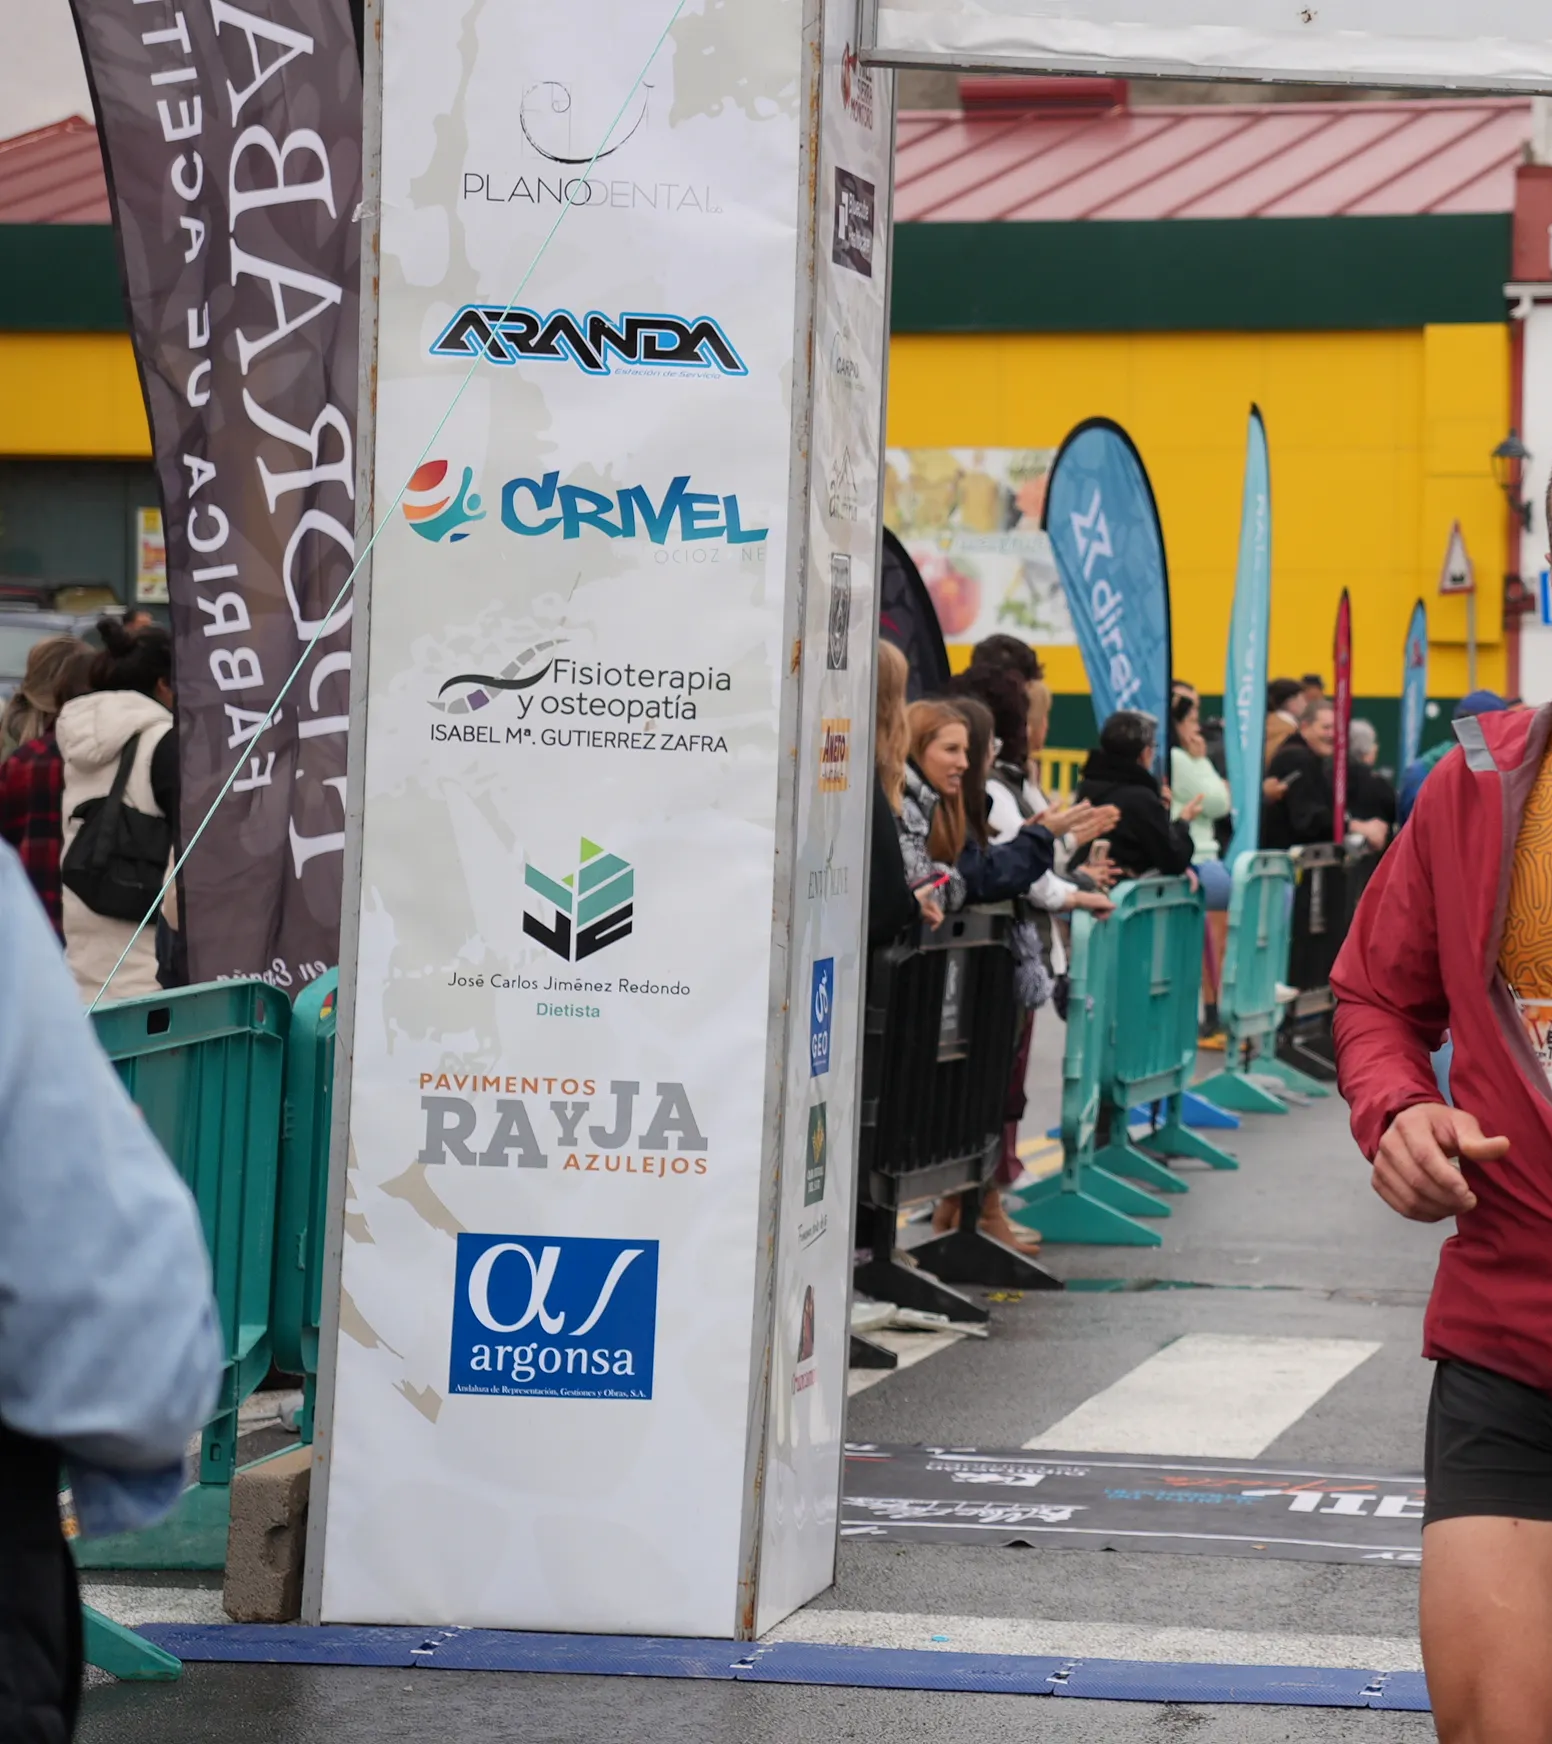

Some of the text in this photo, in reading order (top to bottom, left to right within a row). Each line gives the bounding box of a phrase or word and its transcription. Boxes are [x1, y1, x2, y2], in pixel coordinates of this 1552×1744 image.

[429, 304, 749, 376] ARANDA
[614, 367, 722, 380] Estación de Servicio
[501, 470, 769, 545] CRIVEL
[552, 658, 732, 695] Fisioterapia
[517, 692, 698, 724] y osteopatía
[430, 724, 502, 744] ISABEL
[540, 727, 657, 751] GUTIERREZ
[660, 733, 729, 753] ZAFRA
[447, 972, 691, 996] José Carlos Jiménez Redondo
[535, 1002, 601, 1018] Dietista
[812, 1032, 829, 1059] GEO
[419, 1073, 597, 1097] PAVIMENTOS
[562, 1153, 709, 1178] AZULEJOS
[469, 1342, 636, 1383] argonsa
[490, 1385, 500, 1394] de
[501, 1385, 559, 1396] Representación,
[560, 1387, 596, 1397] Gestiones
[603, 1388, 629, 1398] Obras,
[630, 1390, 647, 1398] S.A.
